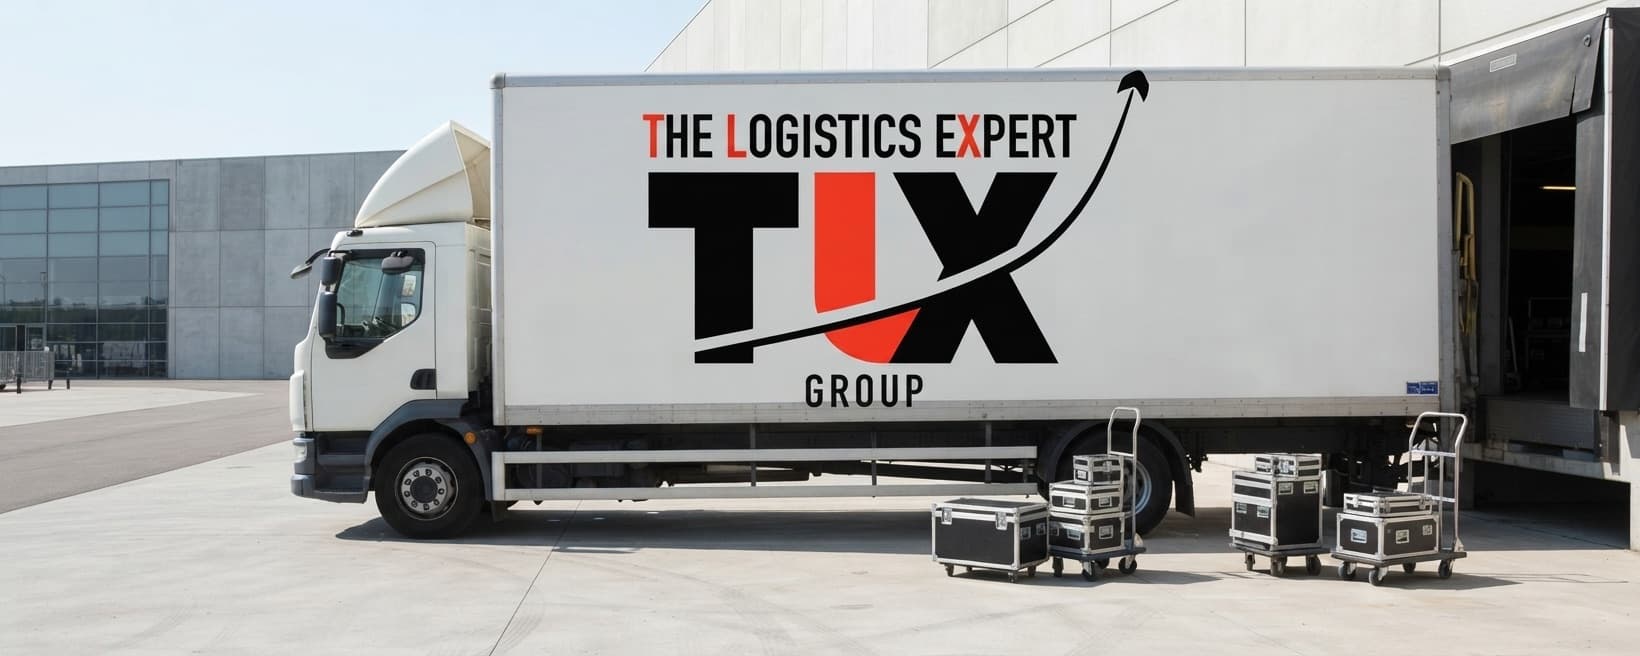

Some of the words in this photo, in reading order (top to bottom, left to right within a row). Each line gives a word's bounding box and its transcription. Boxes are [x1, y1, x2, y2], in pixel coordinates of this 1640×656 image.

[643, 114, 712, 158] THE
[728, 114, 921, 158] LOGISTICS
[936, 114, 1077, 158] EXPERT
[806, 374, 923, 407] GROUP
